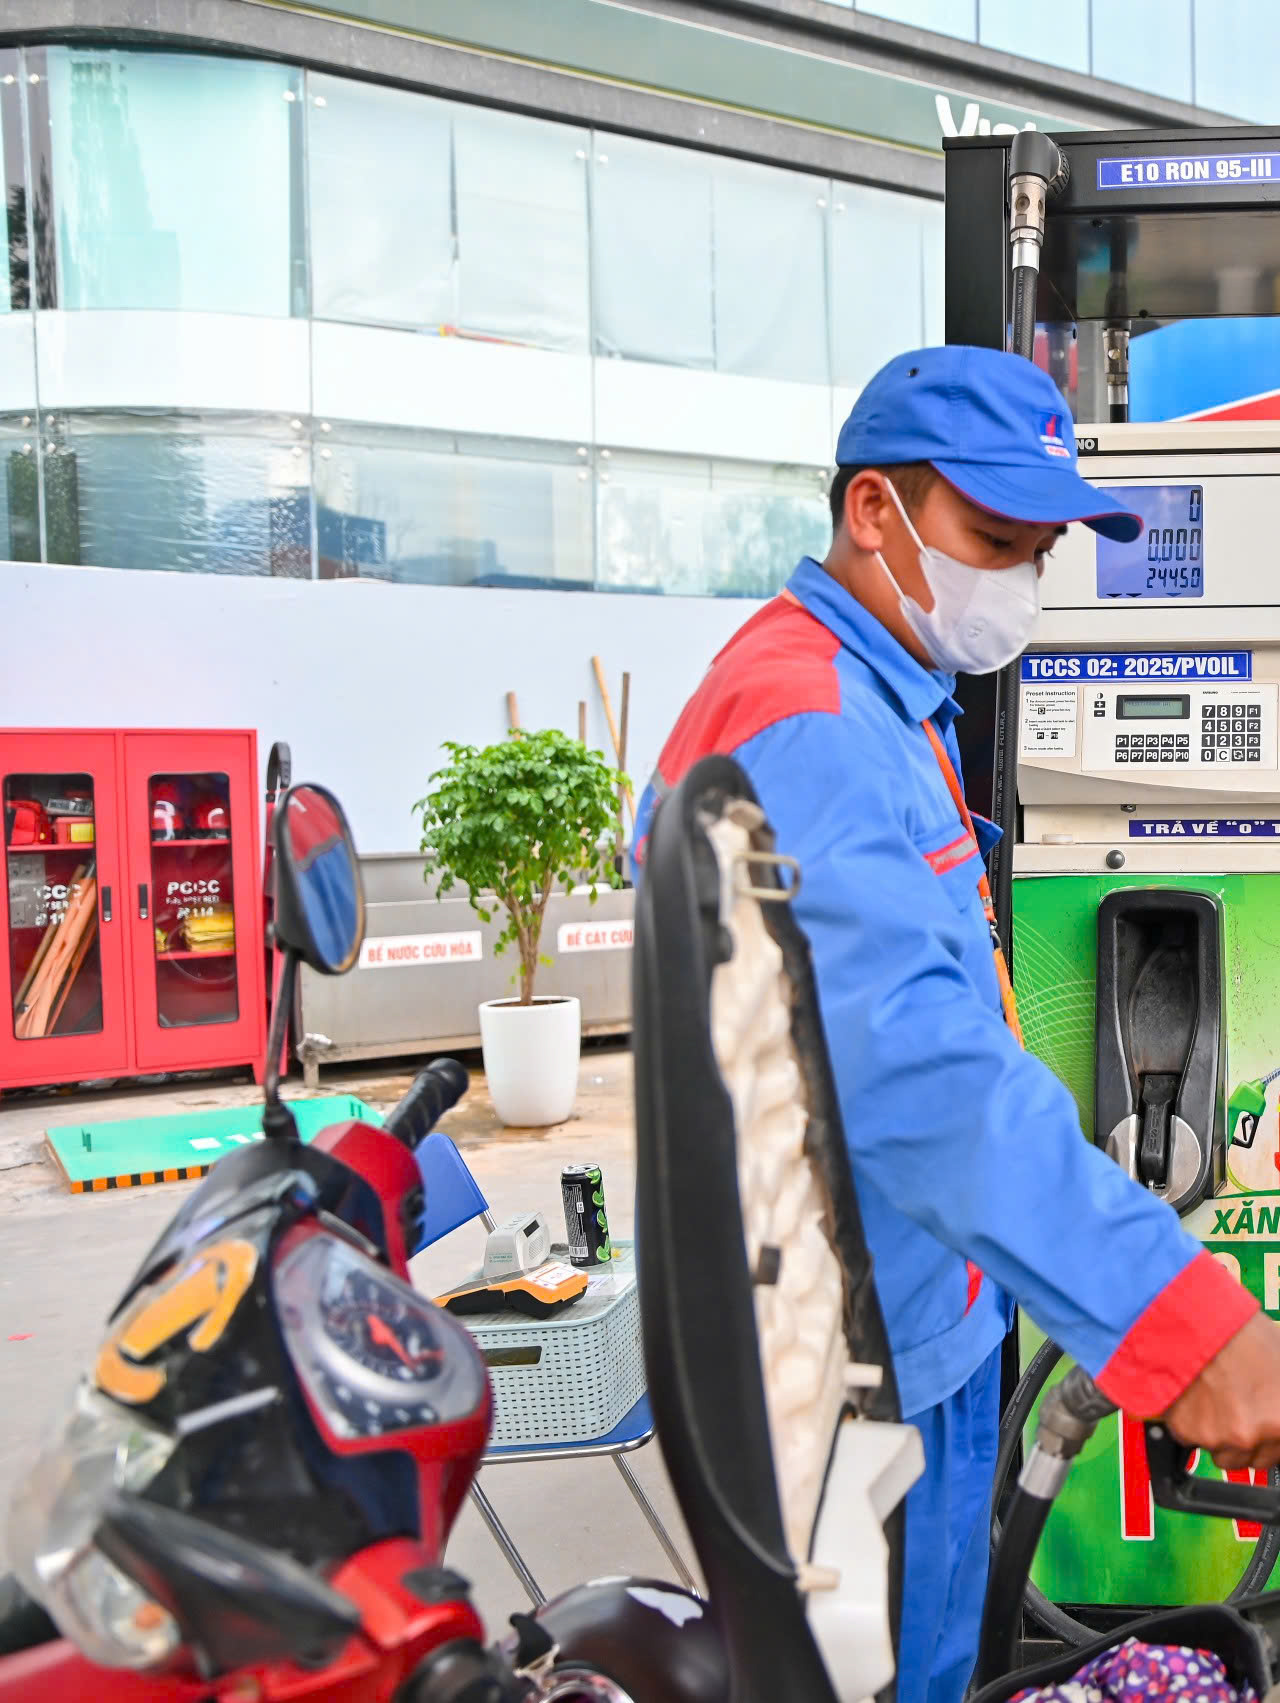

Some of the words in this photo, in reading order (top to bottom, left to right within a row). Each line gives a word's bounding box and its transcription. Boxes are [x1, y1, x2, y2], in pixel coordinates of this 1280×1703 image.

[1121, 163, 1159, 182] E10
[1165, 160, 1209, 180] RON
[1216, 157, 1272, 178] 95-III
[1189, 489, 1200, 522] 0
[1146, 567, 1201, 588] 24450
[1028, 658, 1081, 677] TCCS
[1087, 658, 1118, 676] 02:
[1124, 656, 1239, 676] 2025/PVOIL
[1206, 707, 1212, 716] 7
[1220, 707, 1227, 716] 8
[1236, 707, 1242, 716] 9
[1205, 722, 1212, 731] 4
[1220, 722, 1227, 731] 5
[1235, 721, 1242, 731] 6
[1117, 737, 1127, 745] P1
[1132, 737, 1143, 745] P2
[1147, 737, 1158, 745] P3
[1162, 737, 1173, 745] P4
[1176, 737, 1188, 745] P5
[1206, 736, 1210, 745] 1
[1220, 736, 1226, 745] 2
[1235, 736, 1242, 745] 3
[1117, 752, 1127, 760] P6
[1132, 752, 1143, 760] P7
[1147, 752, 1158, 760] P8
[1162, 752, 1173, 760] P9
[1176, 752, 1188, 760] P10
[1205, 751, 1211, 760] 0
[1219, 751, 1227, 760] C
[1142, 820, 1186, 834] TRẢ
[1192, 819, 1219, 834] VỀ
[167, 879, 220, 895] PCCC
